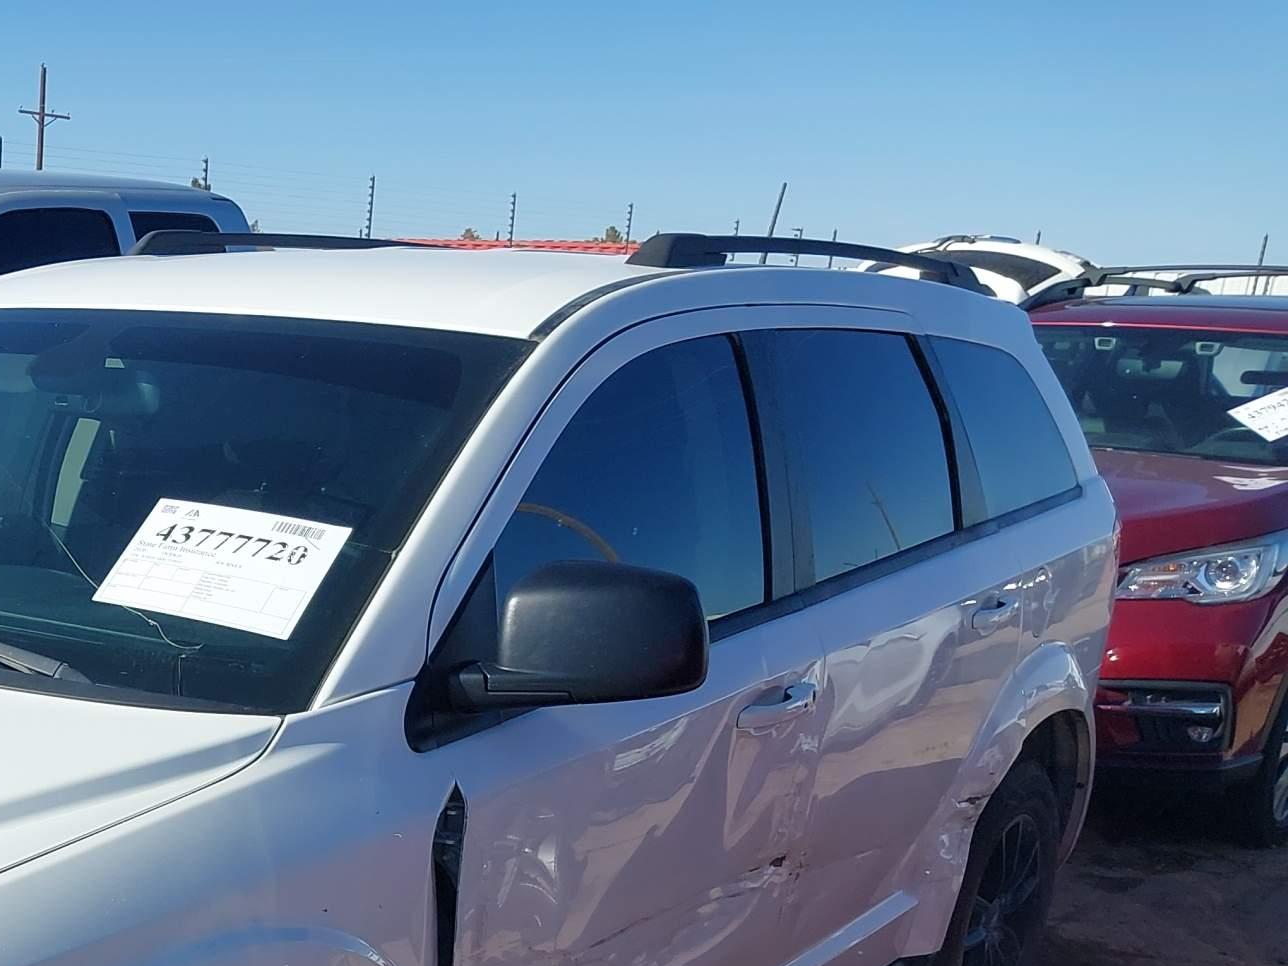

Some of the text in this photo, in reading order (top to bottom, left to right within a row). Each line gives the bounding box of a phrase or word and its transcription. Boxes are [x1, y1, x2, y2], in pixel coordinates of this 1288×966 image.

[138, 539, 157, 548] State
[157, 542, 178, 552] Farm
[179, 545, 217, 558] Insurance
[156, 523, 309, 566] 43777720
